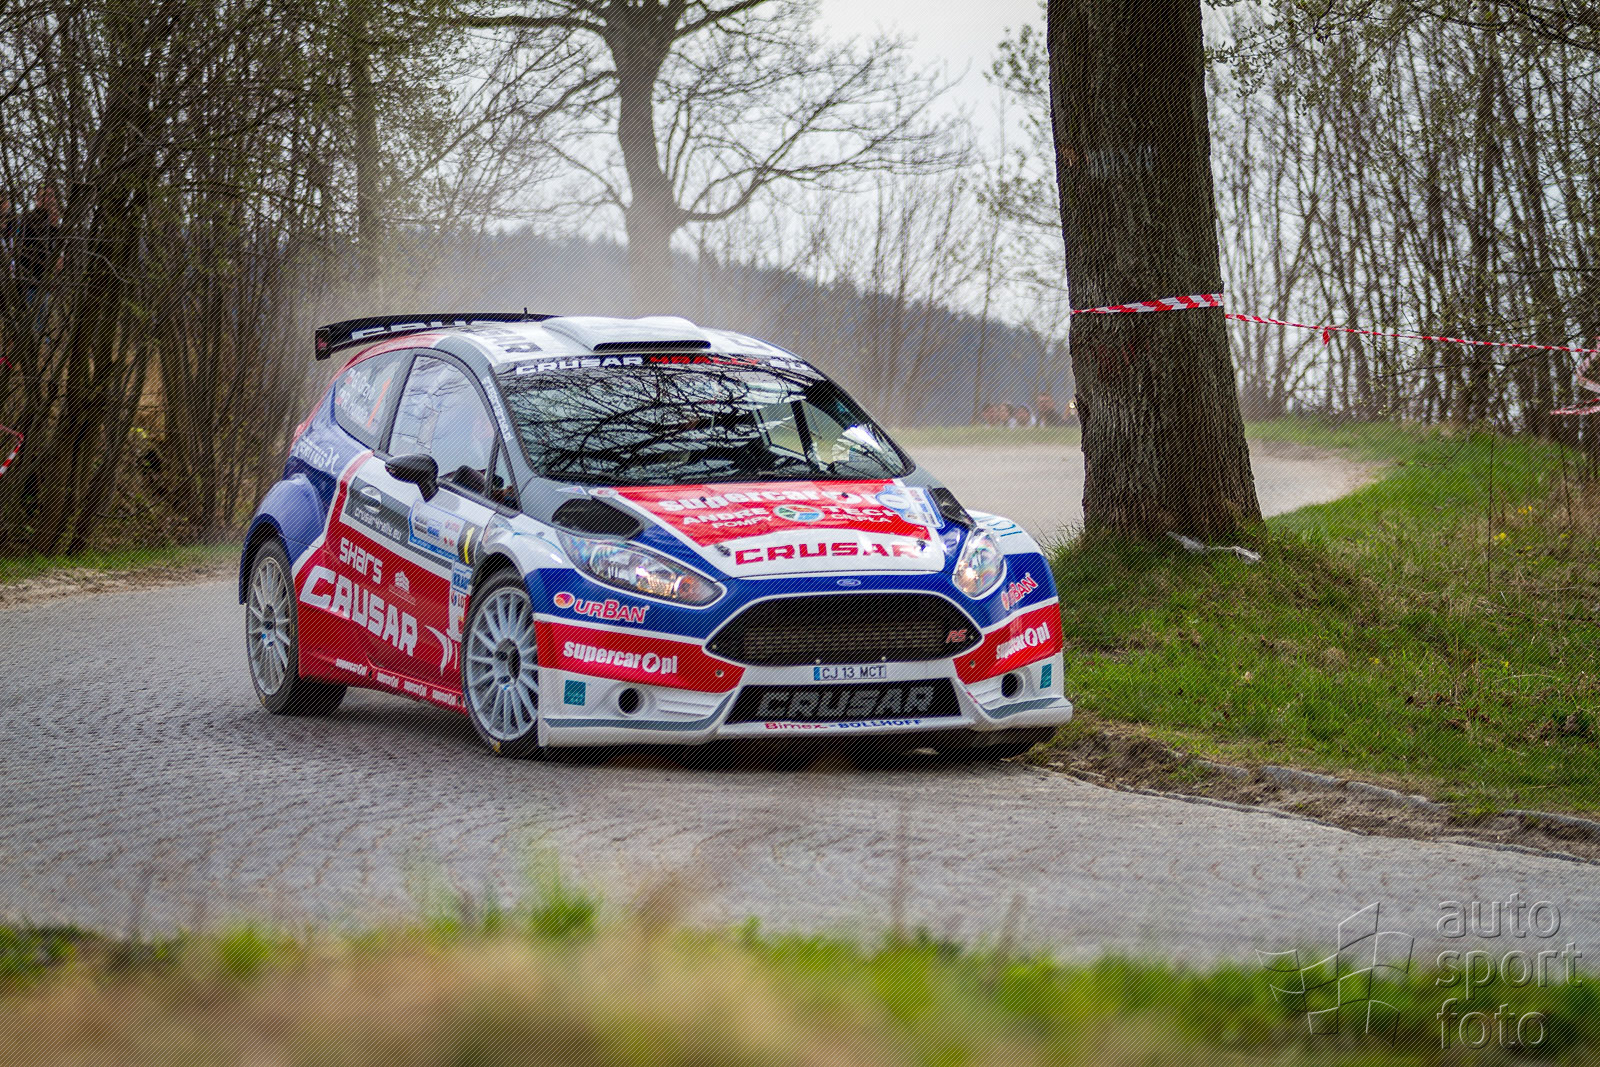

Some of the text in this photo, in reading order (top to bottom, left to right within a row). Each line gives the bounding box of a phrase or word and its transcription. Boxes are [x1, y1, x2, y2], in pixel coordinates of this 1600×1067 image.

[683, 507, 770, 526] ANDRE
[712, 514, 774, 530] POMPY
[464, 527, 475, 564] 1
[735, 542, 920, 566] CRUSAR
[300, 565, 418, 657] CRUSAR
[946, 630, 968, 643] RS
[822, 665, 884, 679] CJ 13 MCT
[755, 686, 936, 718] CRUSAR
